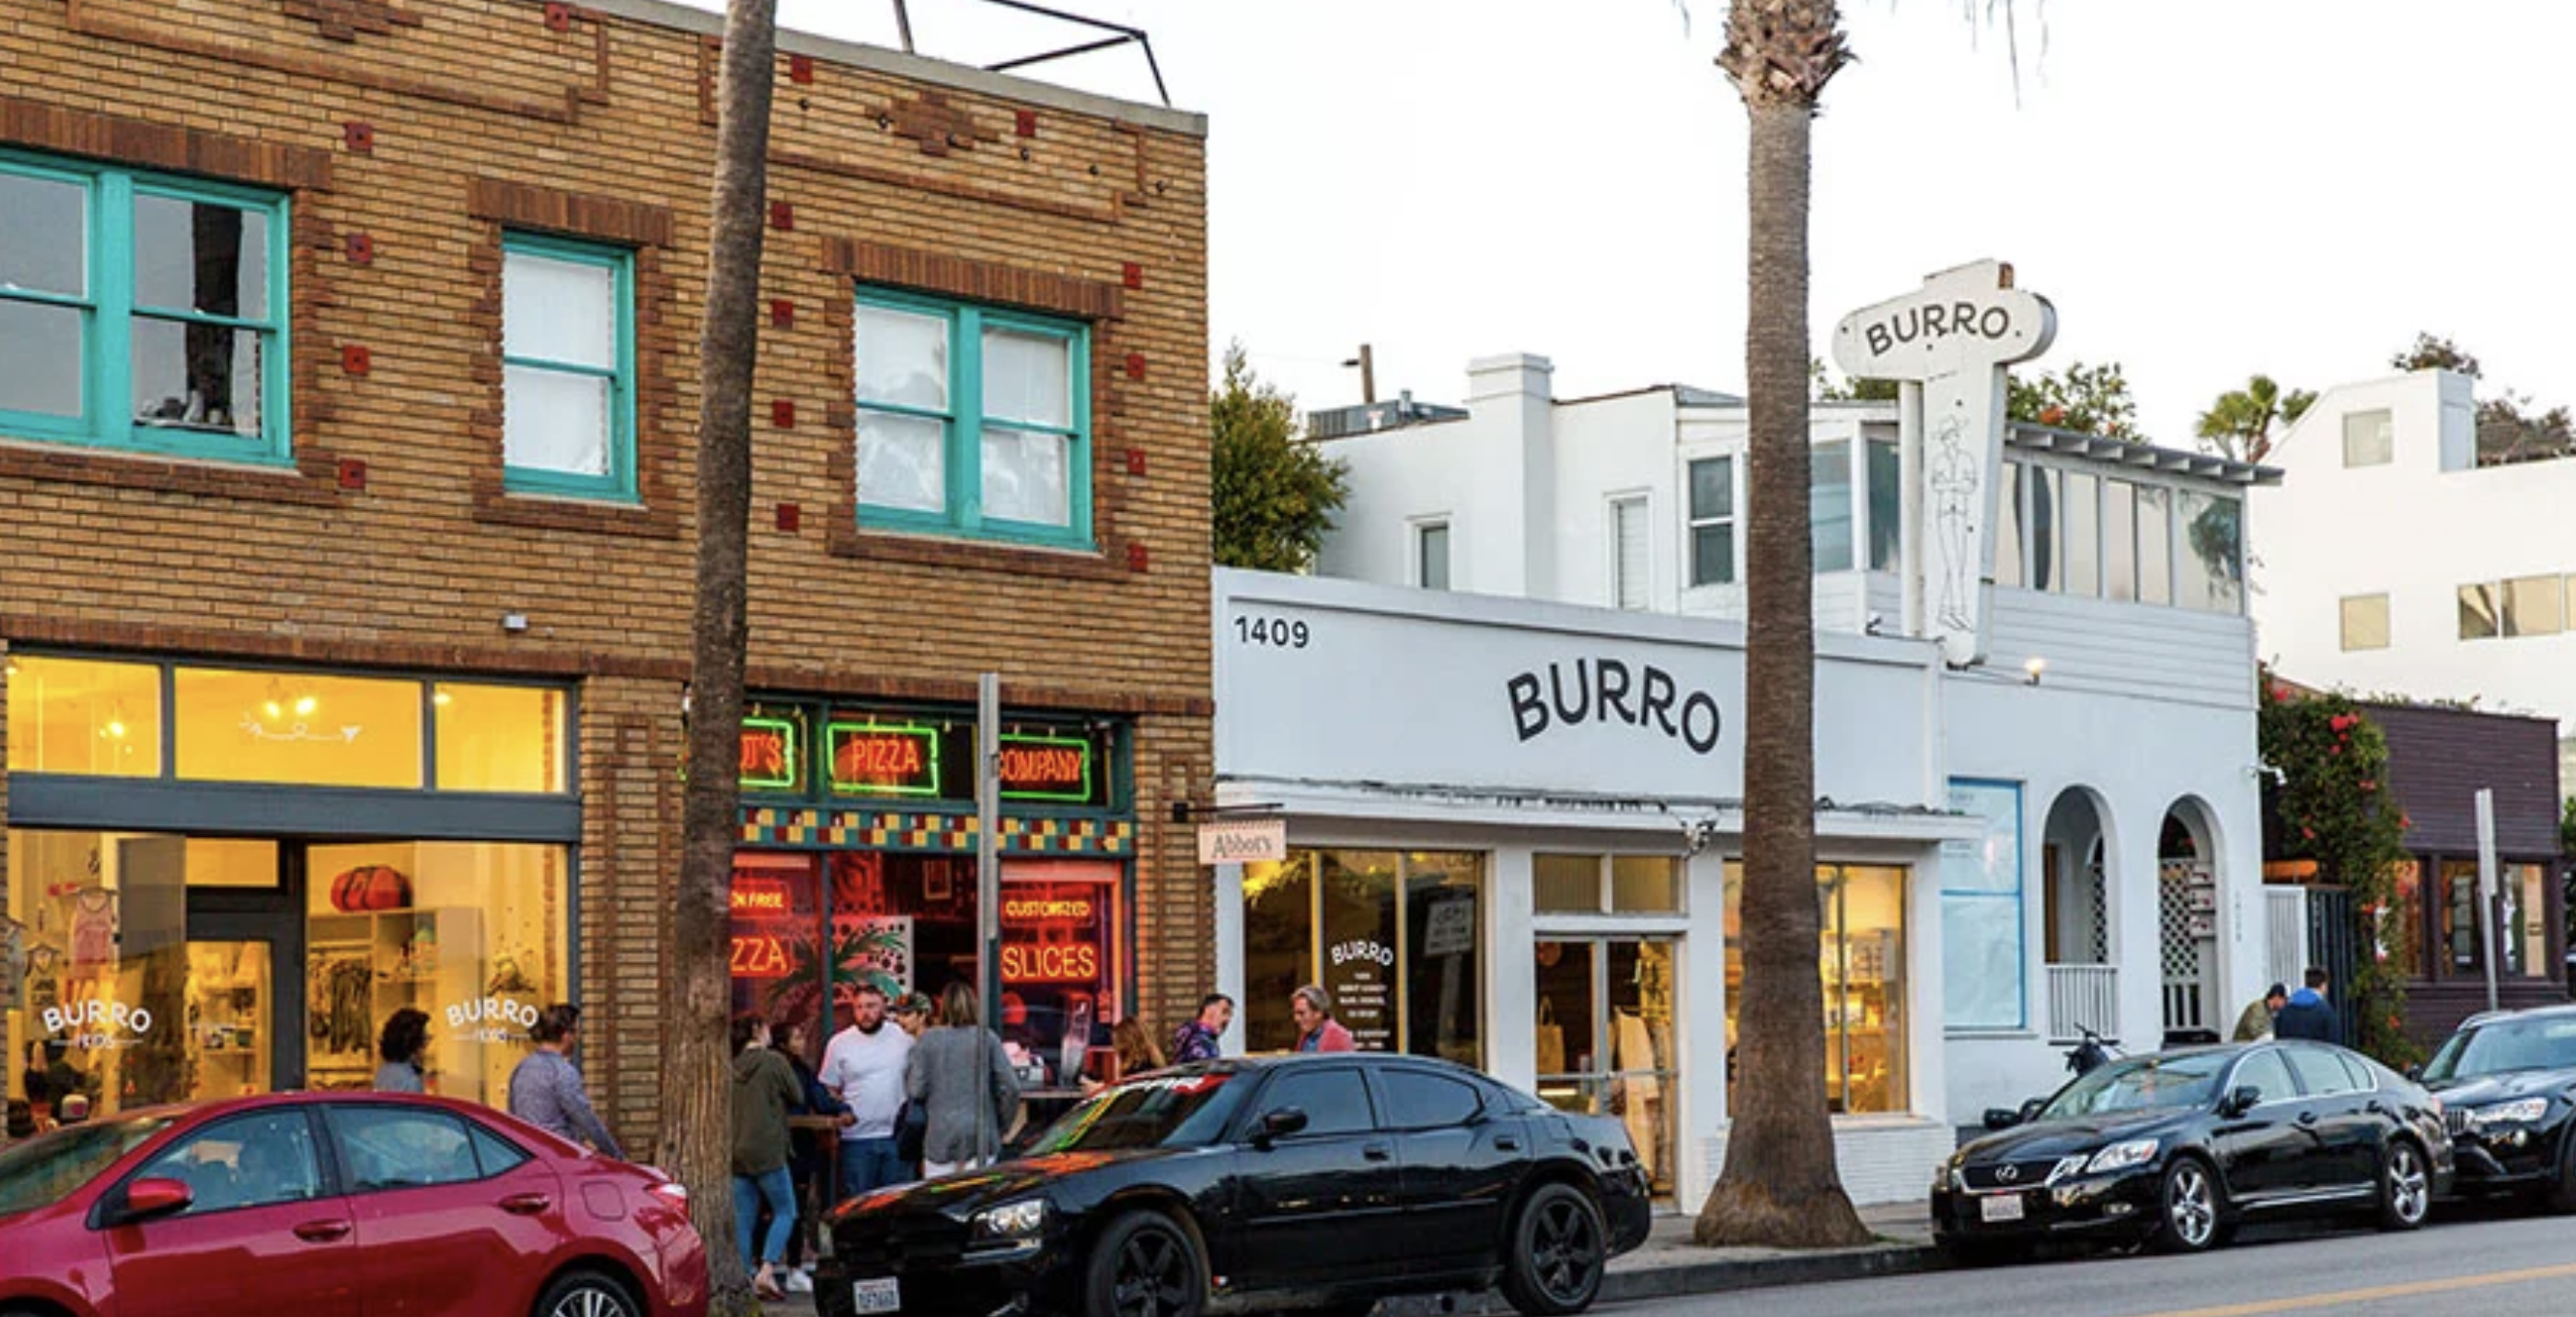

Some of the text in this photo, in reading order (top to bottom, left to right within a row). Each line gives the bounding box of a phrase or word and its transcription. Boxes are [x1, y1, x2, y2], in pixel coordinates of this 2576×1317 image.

[1866, 301, 2010, 357] BURRO
[1235, 615, 1309, 649] 1409
[1507, 658, 1721, 755] BURRO
[852, 738, 921, 773] PIZZA
[1211, 833, 1272, 859] Abbot's
[1002, 946, 1096, 979] SLICES
[1331, 939, 1394, 966] BURRO
[43, 999, 152, 1034] BURRO
[445, 996, 540, 1028] BURRO
